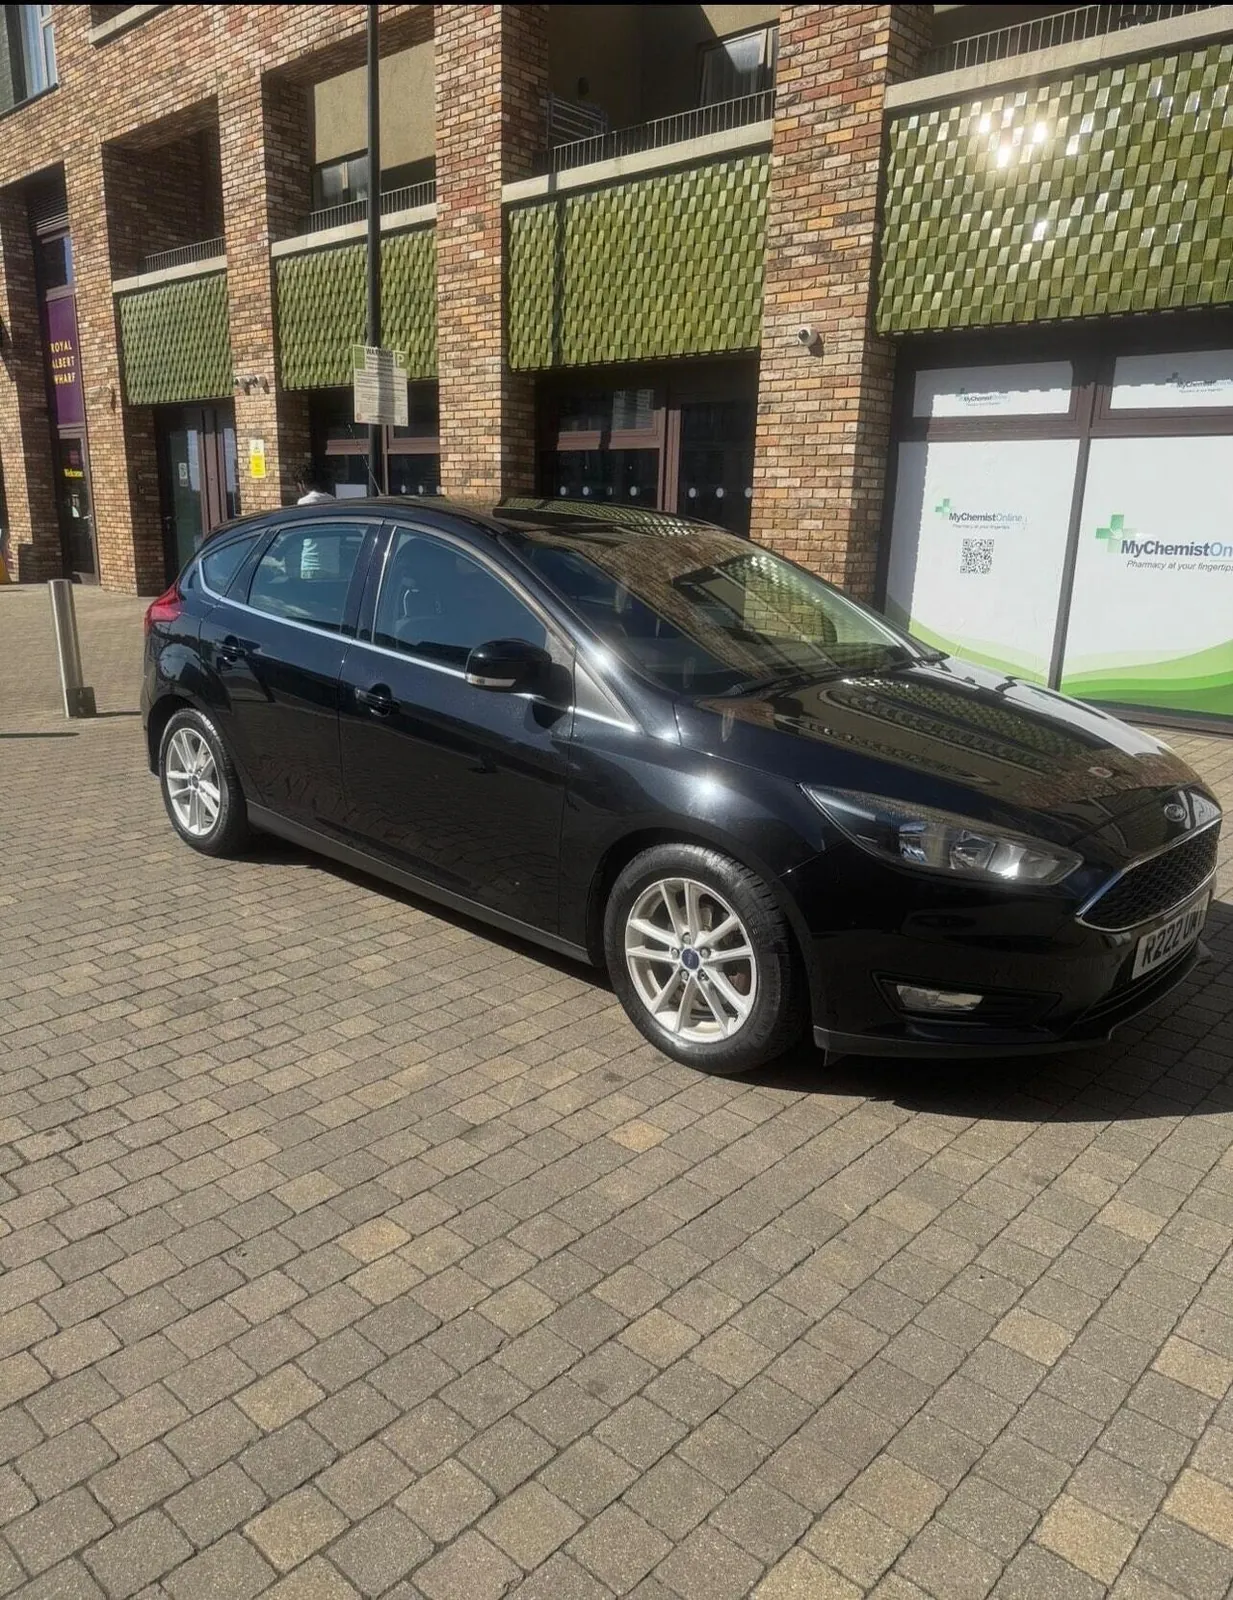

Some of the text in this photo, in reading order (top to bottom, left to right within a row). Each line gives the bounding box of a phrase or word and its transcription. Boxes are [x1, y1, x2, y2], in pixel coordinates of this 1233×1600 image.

[50, 340, 73, 353] ROYAL
[366, 348, 394, 357] WARNING
[397, 354, 405, 367] P
[54, 372, 76, 385] WHARF
[948, 512, 1023, 523] MyChemistOnline
[1127, 560, 1167, 571] Pharmacy
[1168, 561, 1177, 569] at
[1177, 562, 1197, 572] your
[1142, 917, 1184, 968] R222
